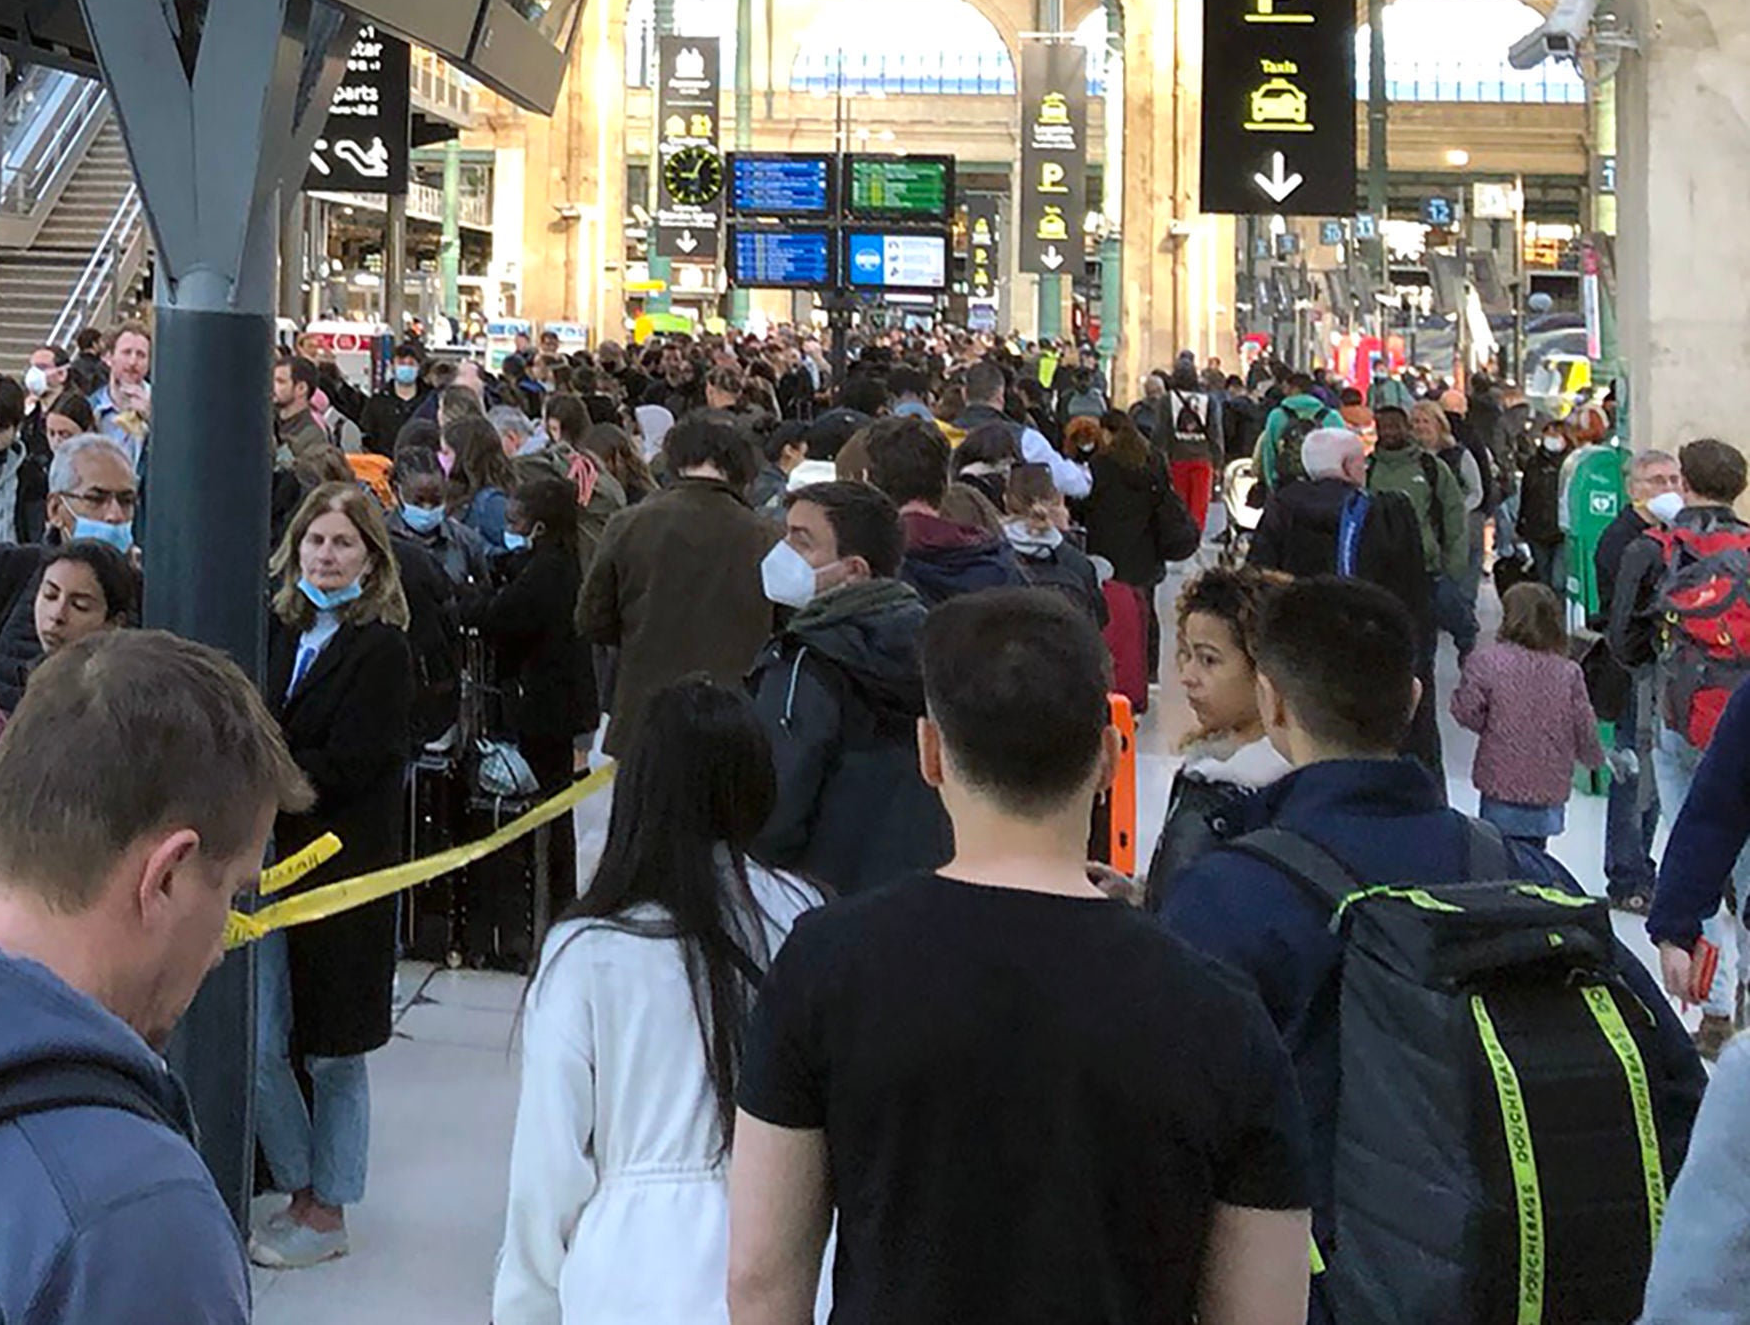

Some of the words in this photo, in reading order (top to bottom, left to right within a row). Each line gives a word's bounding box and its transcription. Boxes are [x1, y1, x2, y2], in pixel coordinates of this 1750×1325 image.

[1260, 59, 1298, 74] Taxis
[1490, 1043, 1530, 1164] DOUCHEBAGS
[1520, 1184, 1540, 1306] DOUCHEBAGS
